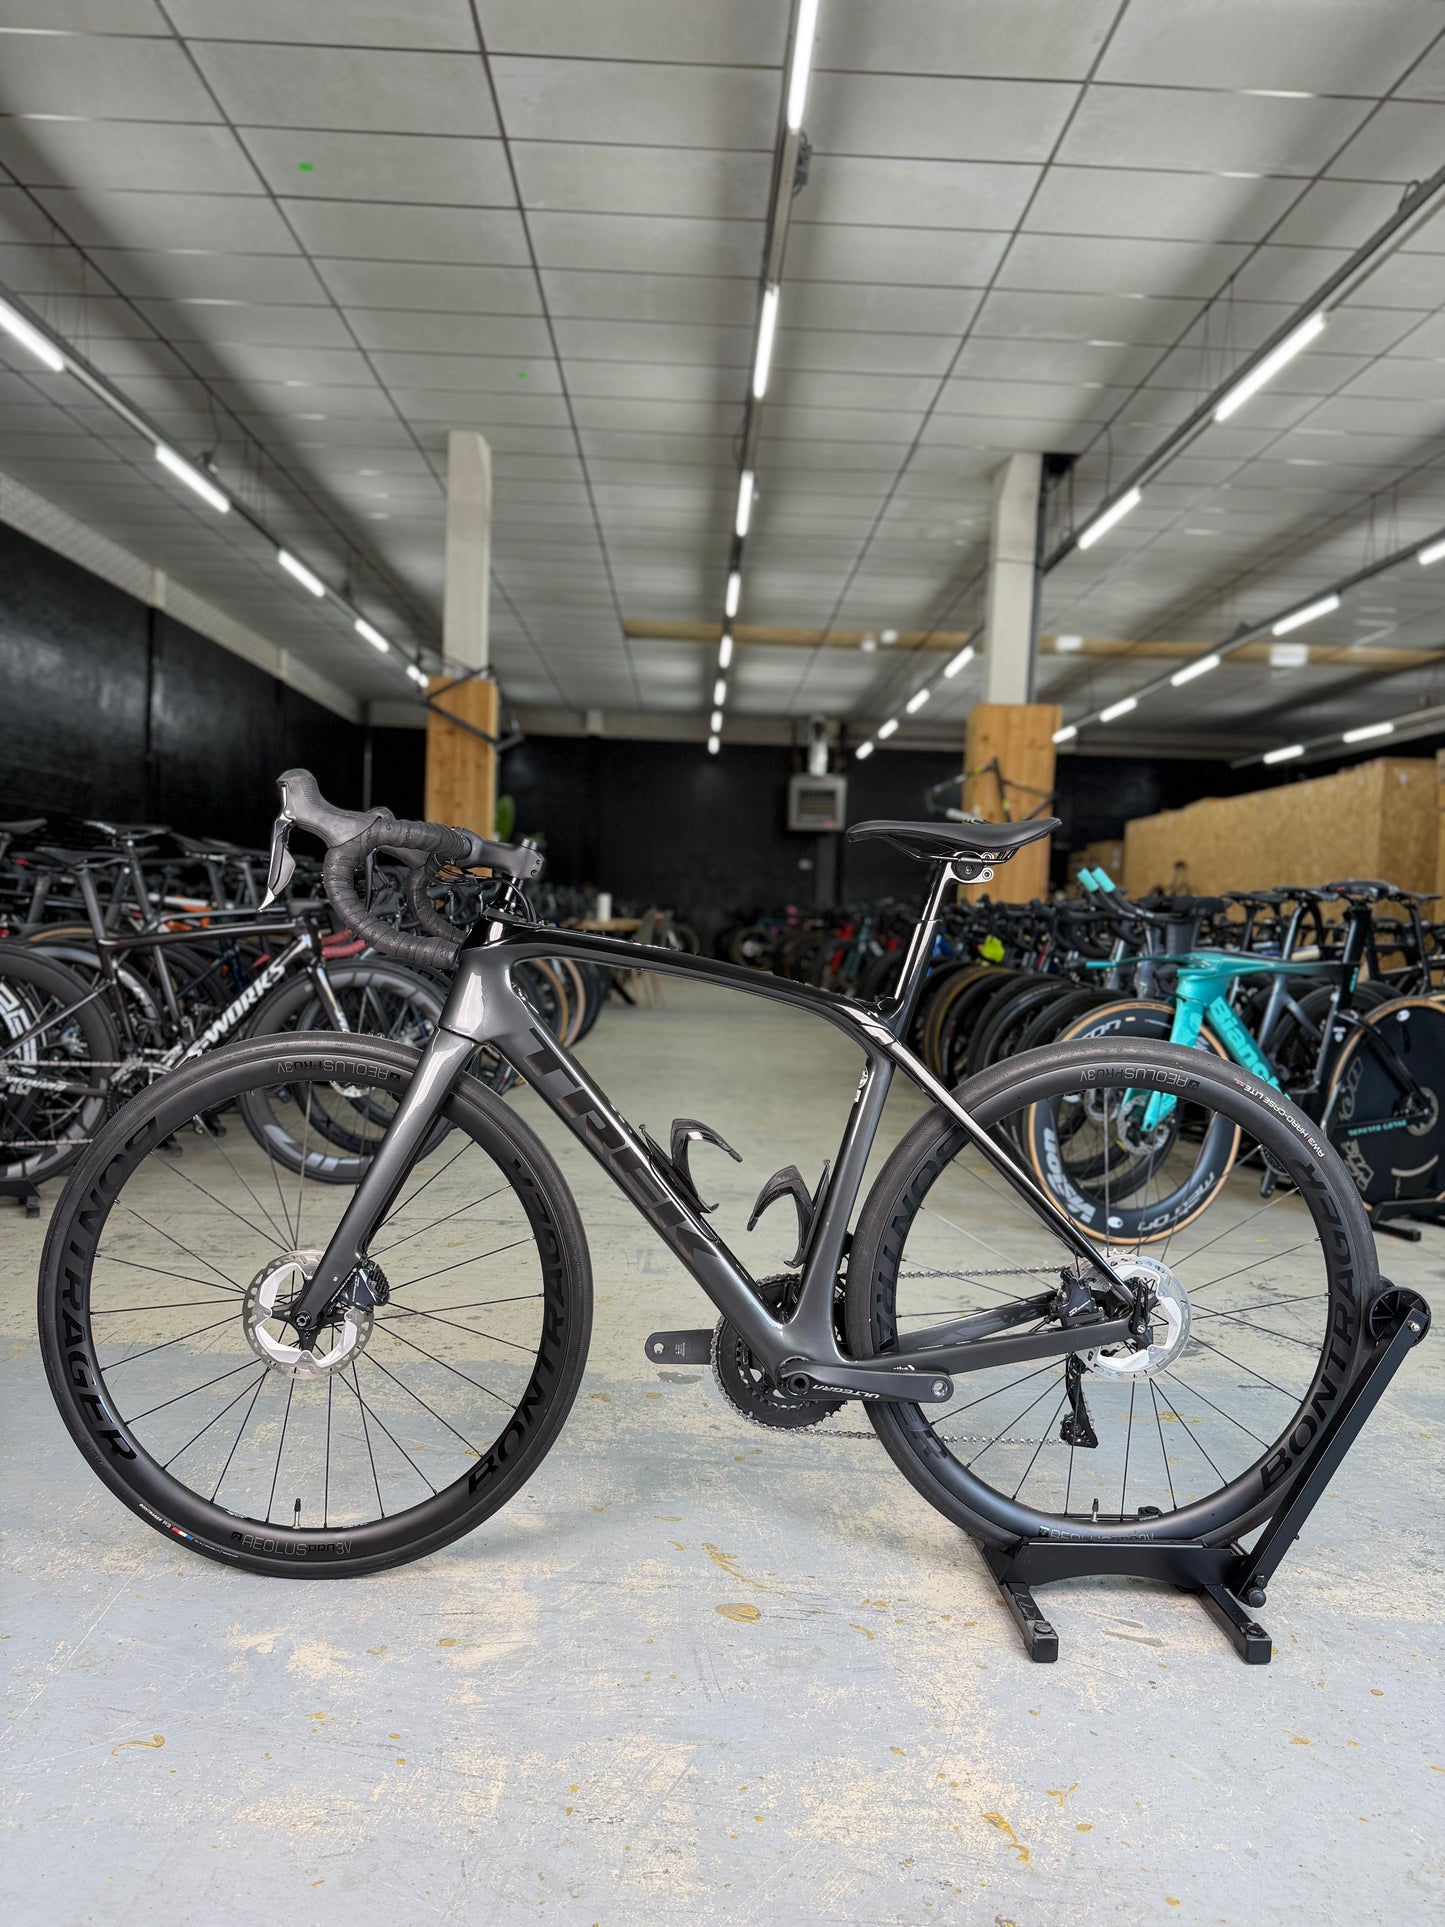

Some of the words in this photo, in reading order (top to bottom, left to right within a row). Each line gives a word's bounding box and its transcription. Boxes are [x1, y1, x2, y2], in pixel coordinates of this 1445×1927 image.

[187, 957, 285, 1058] S-WORKS
[1209, 996, 1291, 1100] Bianc
[277, 1061, 294, 1074] 3V
[323, 1060, 389, 1080] AEOLUS
[1080, 1069, 1096, 1082] 3V
[1123, 1067, 1189, 1088] AEOLUS
[1243, 1084, 1264, 1100] LITE
[1263, 1096, 1309, 1139] HARD-CASE
[522, 1027, 721, 1266] TREK
[1307, 1137, 1325, 1158] AW3
[62, 1115, 161, 1462] BONTRAGER
[468, 1158, 565, 1498] BONTRAGER
[1261, 1160, 1355, 1491] BONTRAGER
[812, 1384, 881, 1399] ULTEGRA
[241, 1535, 307, 1556] AEOLUS
[336, 1540, 353, 1555] 3V
